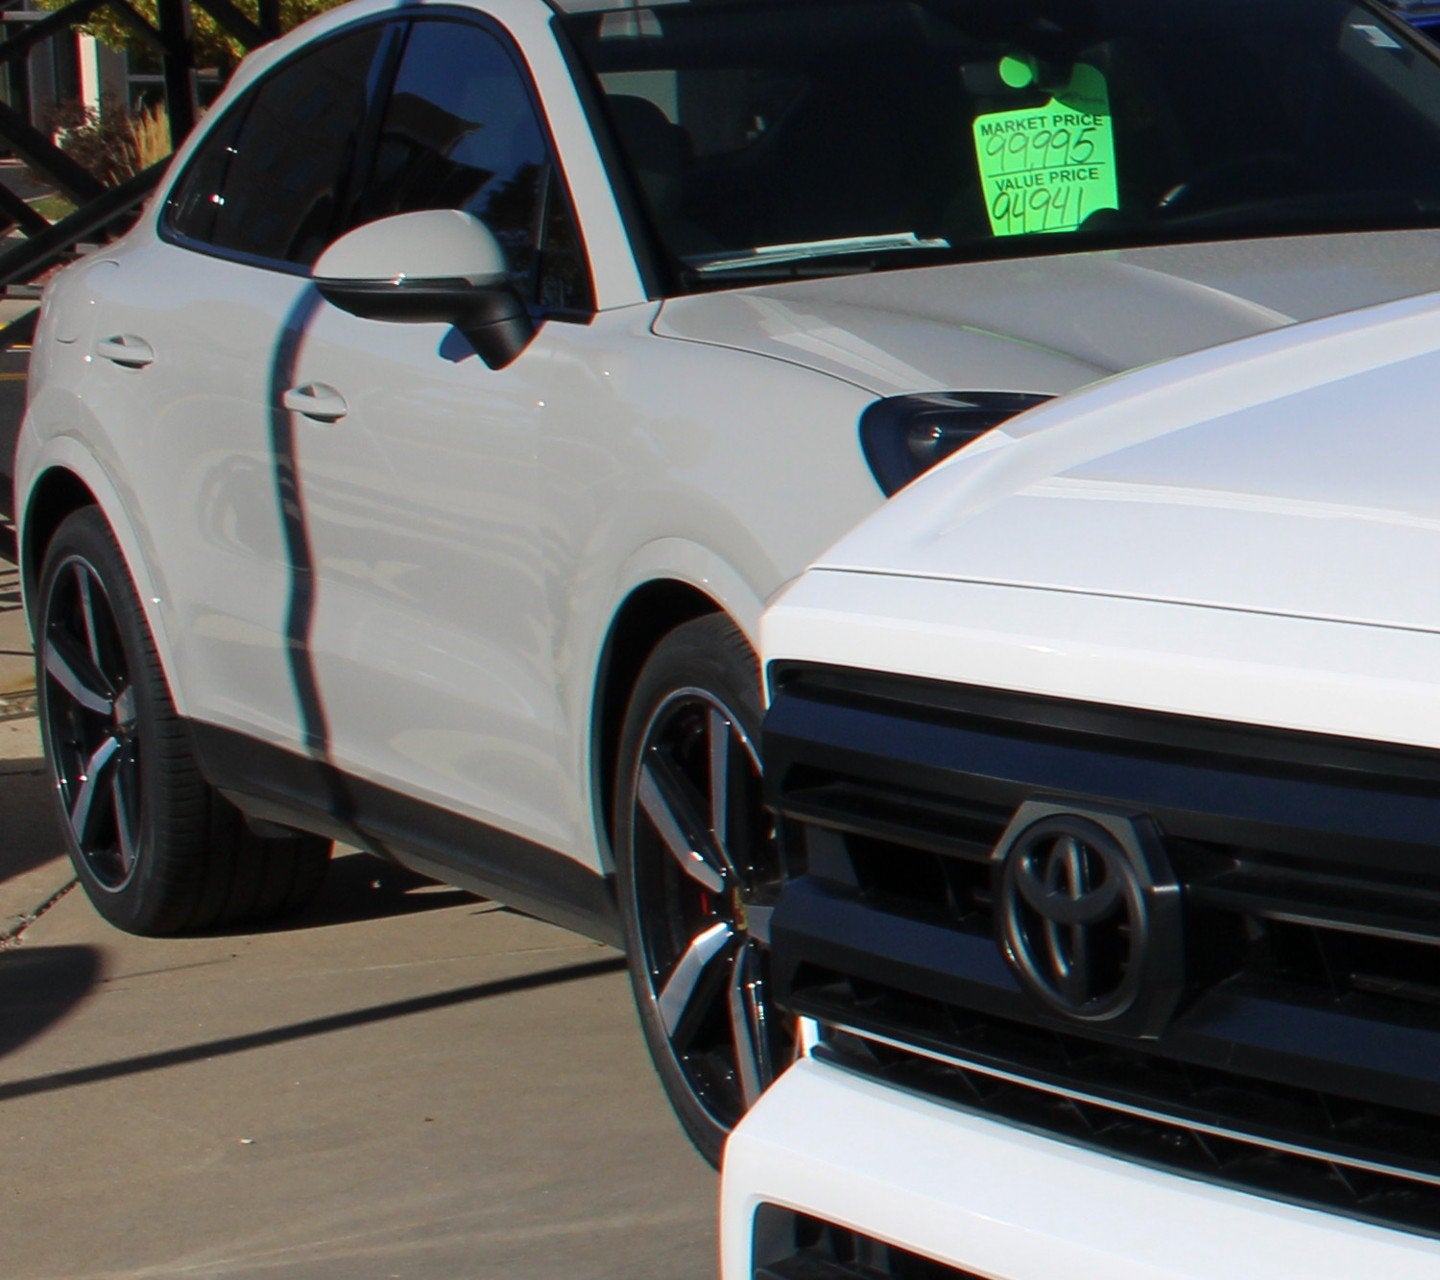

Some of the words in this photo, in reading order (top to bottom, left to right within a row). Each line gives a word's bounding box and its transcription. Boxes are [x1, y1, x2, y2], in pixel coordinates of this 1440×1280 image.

[980, 116, 1047, 136] MARKET
[1052, 113, 1105, 127] PRICE
[995, 172, 1045, 192] VALUE
[1049, 167, 1100, 185] PRICE
